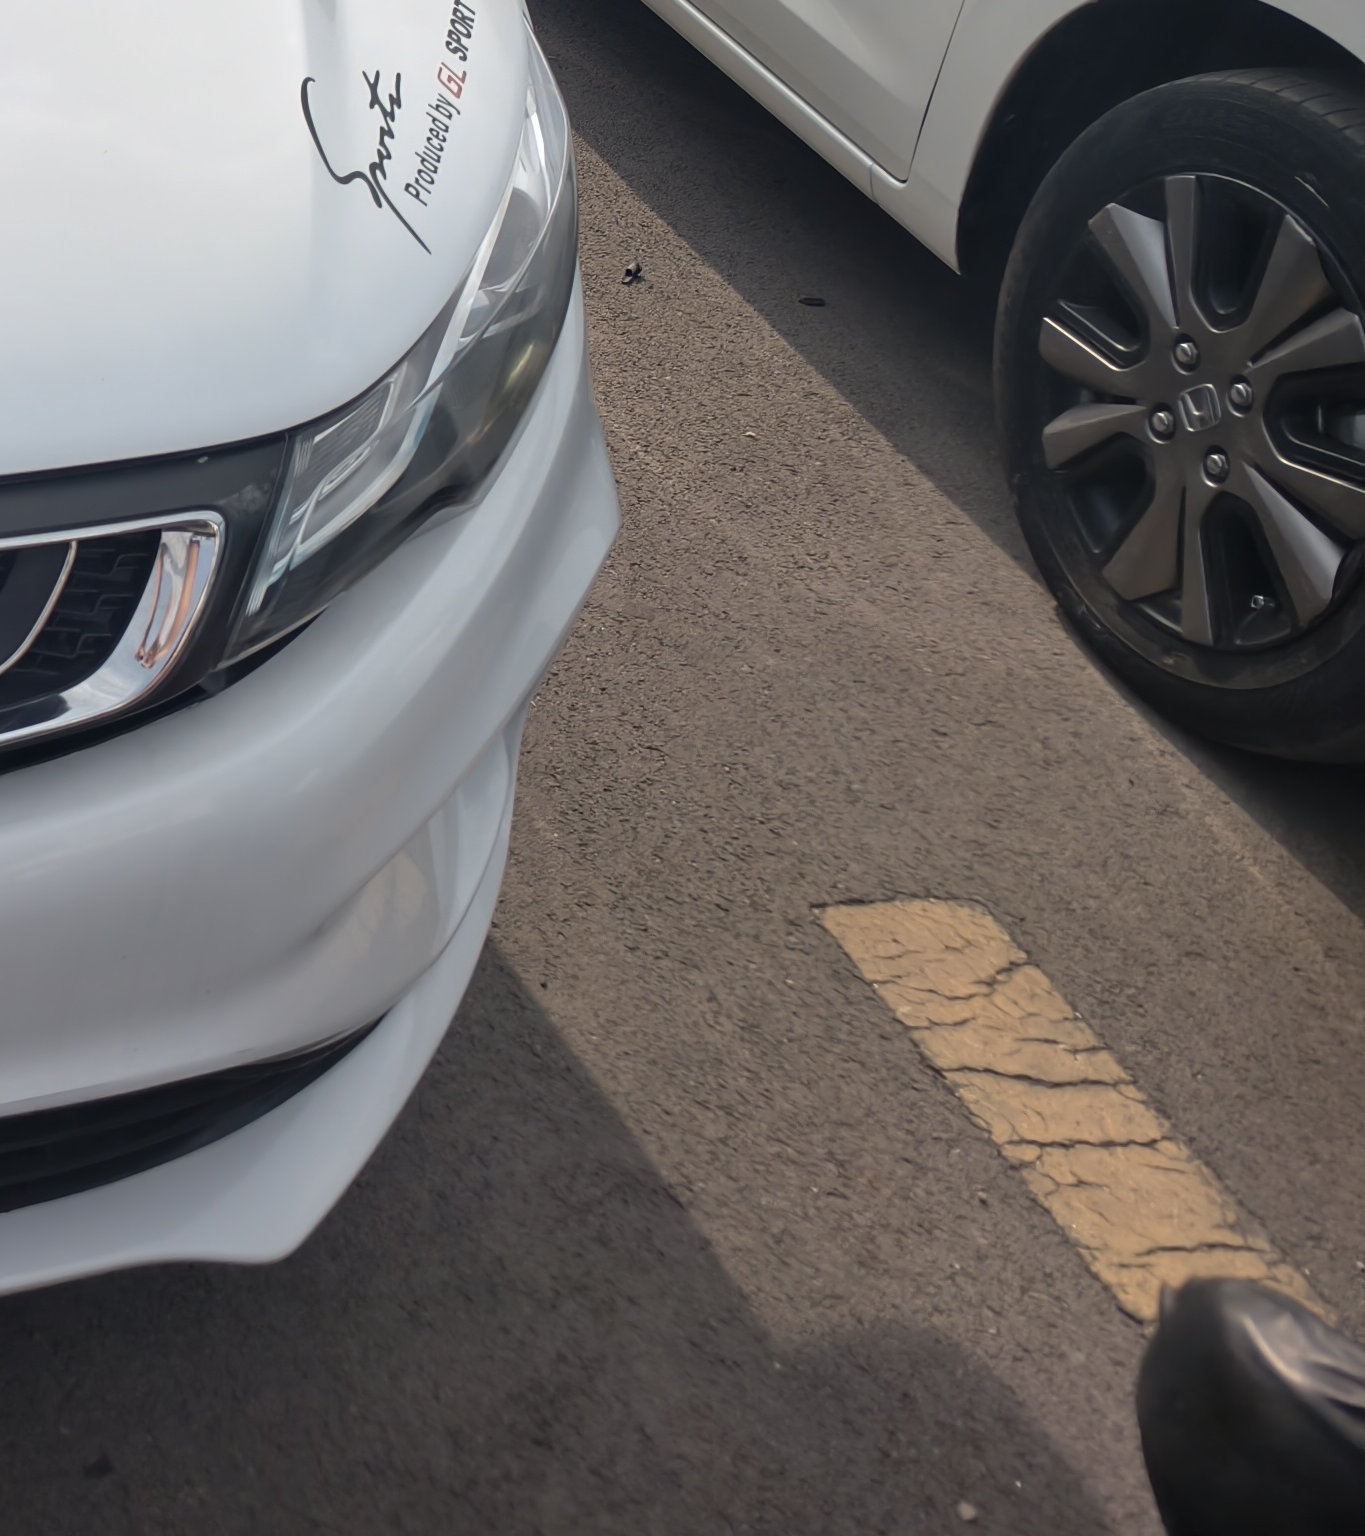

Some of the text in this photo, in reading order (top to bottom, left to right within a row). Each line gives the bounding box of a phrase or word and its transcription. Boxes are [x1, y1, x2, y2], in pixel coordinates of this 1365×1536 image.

[437, 62, 467, 99] GL
[428, 93, 461, 116] by
[404, 110, 450, 207] Produced
